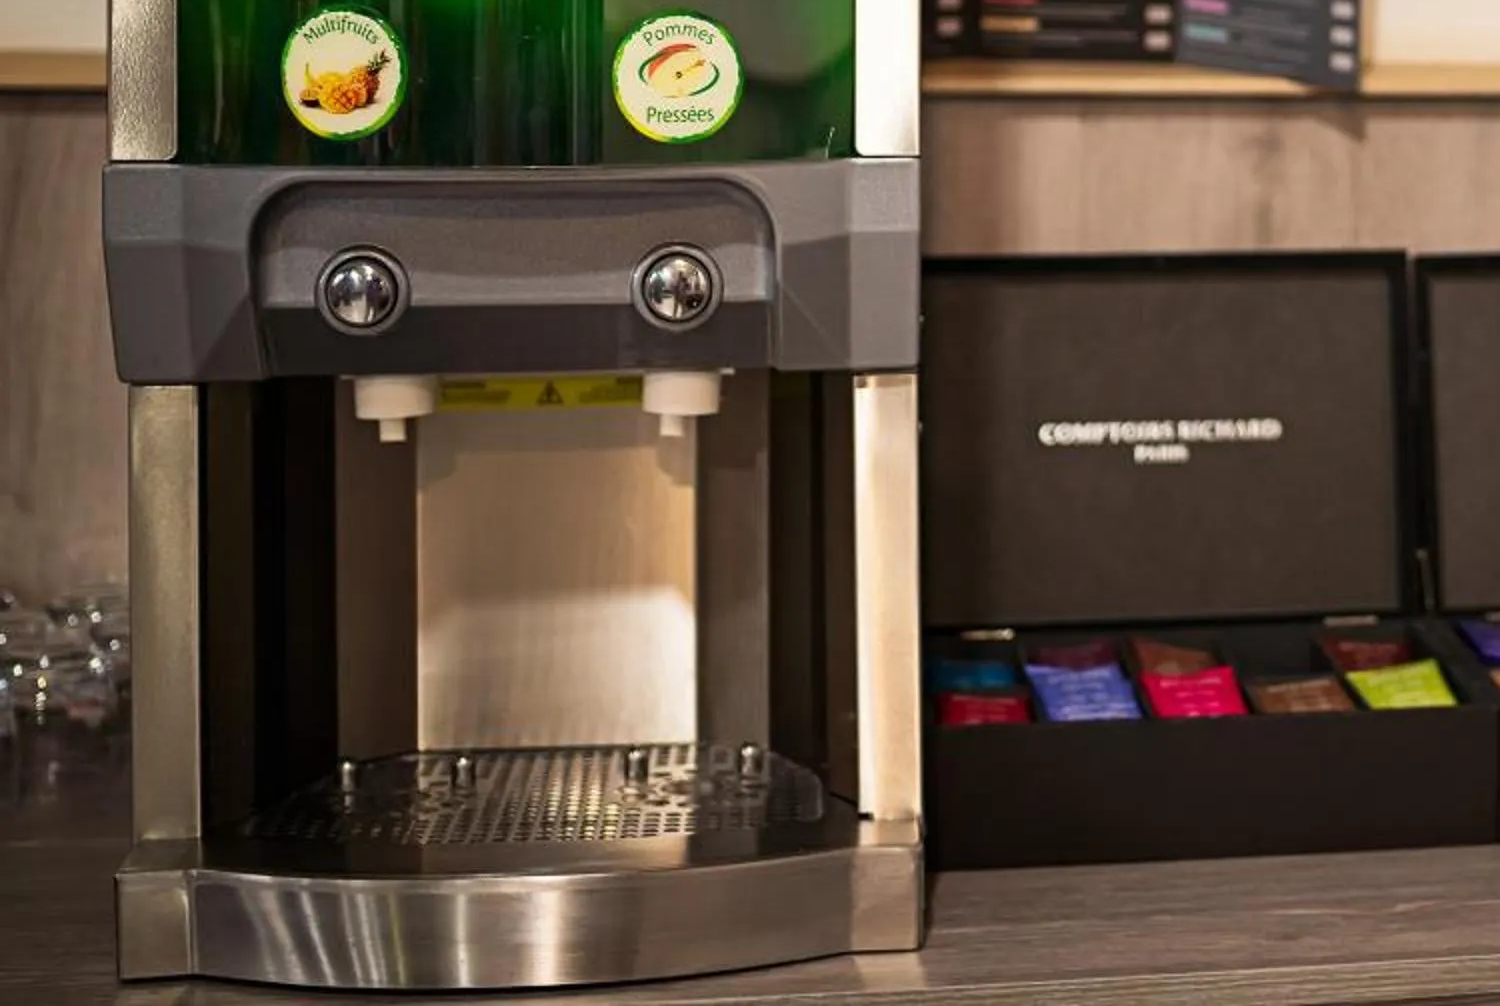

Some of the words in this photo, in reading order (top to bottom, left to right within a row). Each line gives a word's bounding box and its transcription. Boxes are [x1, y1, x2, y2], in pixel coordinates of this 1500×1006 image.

[303, 15, 379, 44] Multifruits
[642, 24, 717, 46] Pommes
[647, 106, 715, 123] Pressées
